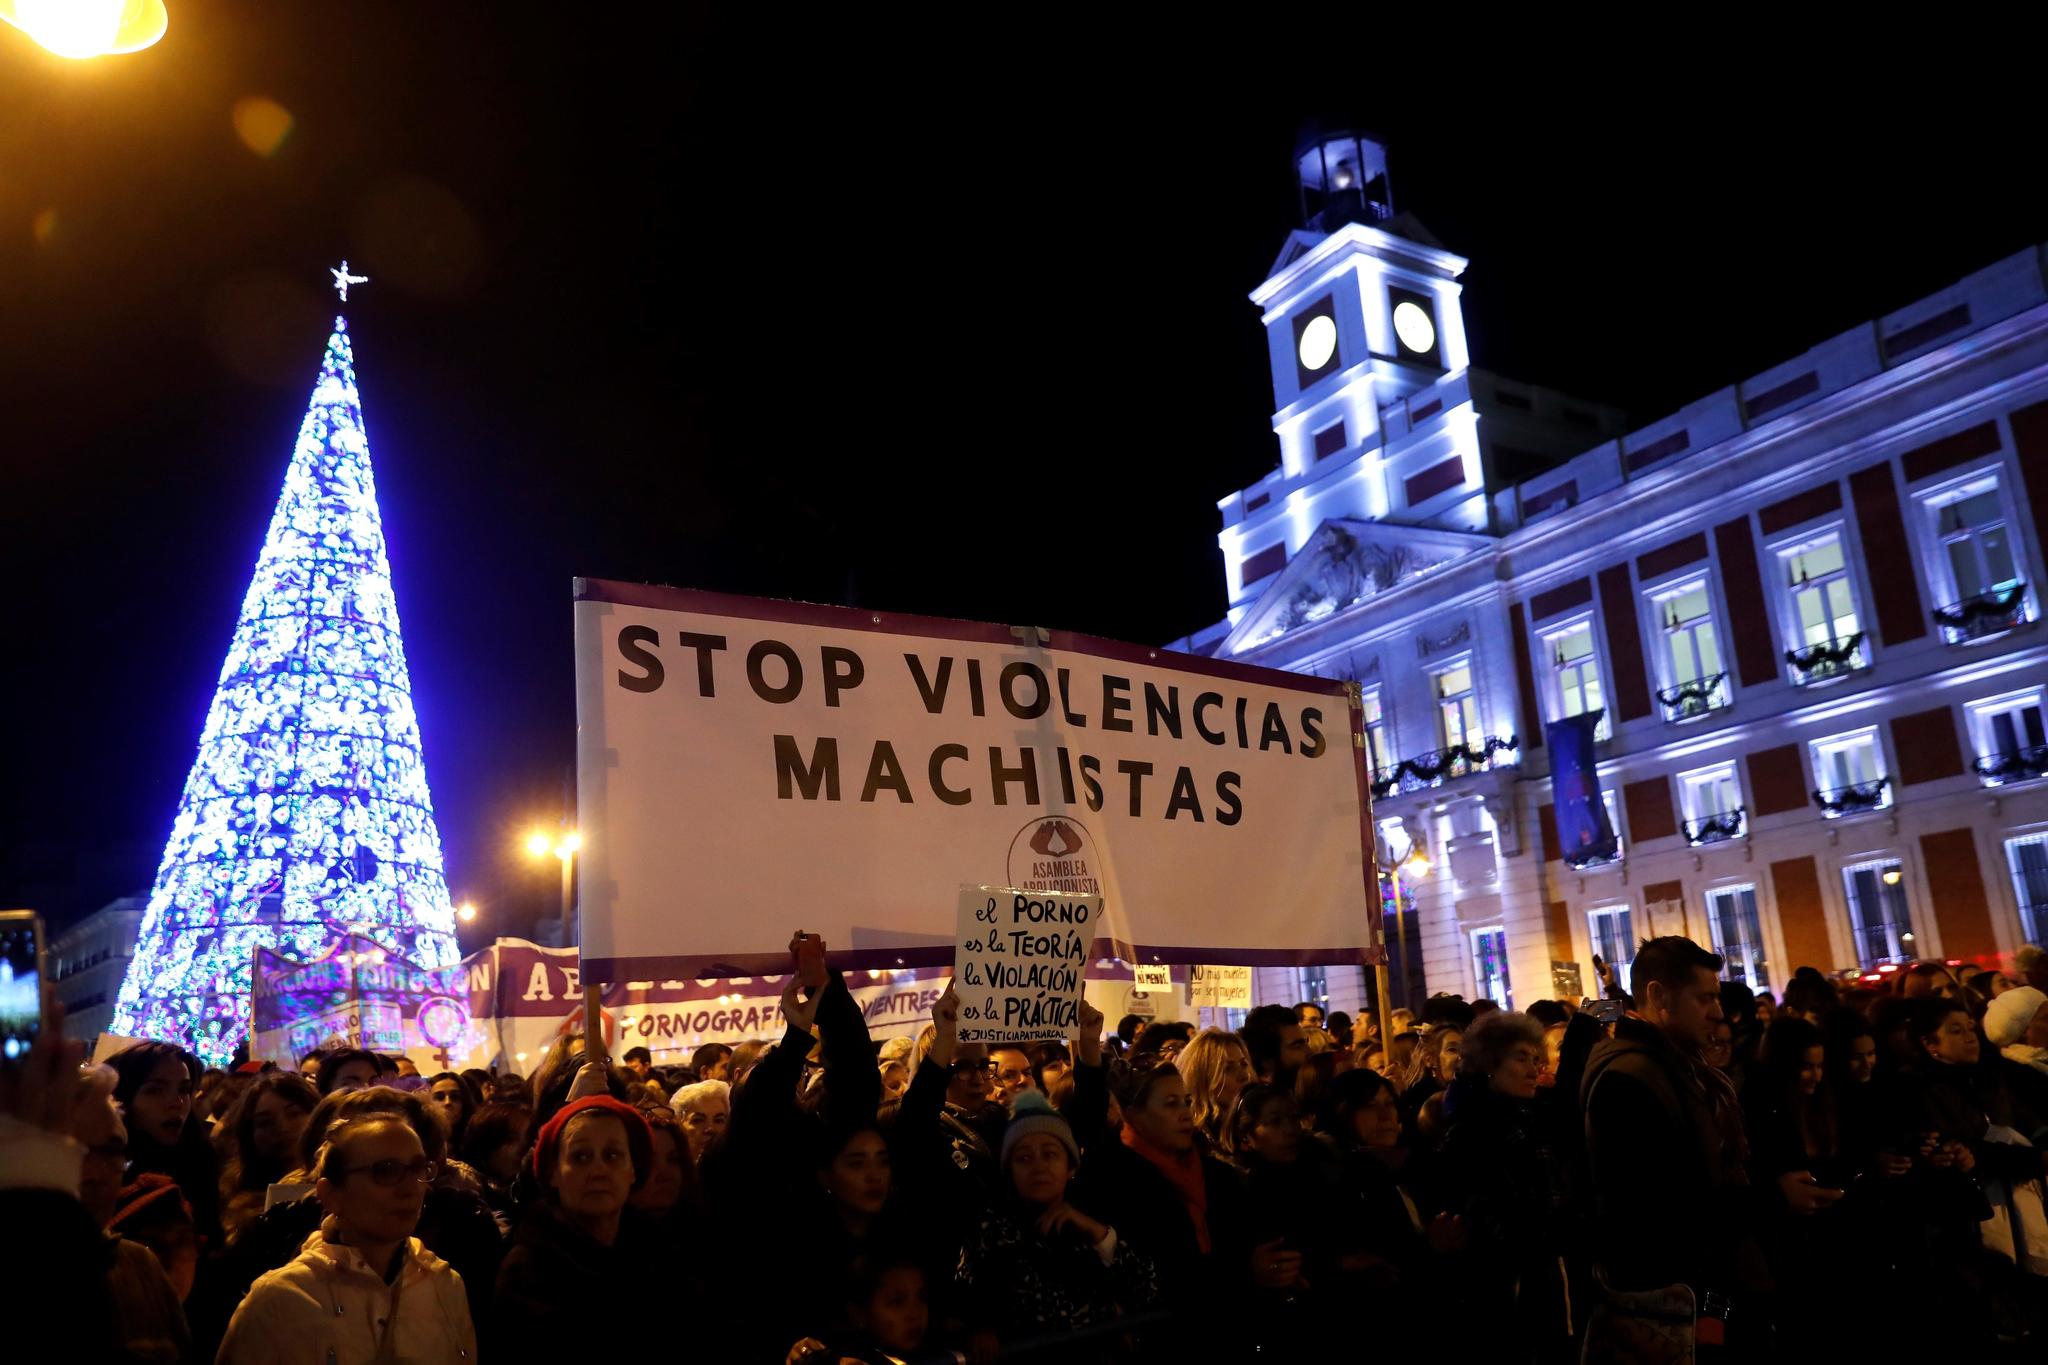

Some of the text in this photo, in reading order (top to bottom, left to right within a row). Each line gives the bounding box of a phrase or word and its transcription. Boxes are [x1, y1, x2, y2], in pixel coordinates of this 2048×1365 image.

[618, 625, 1327, 758] STOP VIOLENCIAS
[773, 734, 1243, 826] MACHISTAS
[1033, 861, 1088, 878] ASAMBLEA
[976, 895, 1089, 924] el PORNO
[964, 939, 983, 953] es
[987, 928, 1006, 952] la
[1008, 929, 1087, 967] TEORÍA,
[964, 962, 983, 986] la
[985, 962, 1077, 993] VIOLACIÓN
[861, 989, 941, 1018] VIENTRES
[963, 991, 1080, 1028] es la PRÁCTICA
